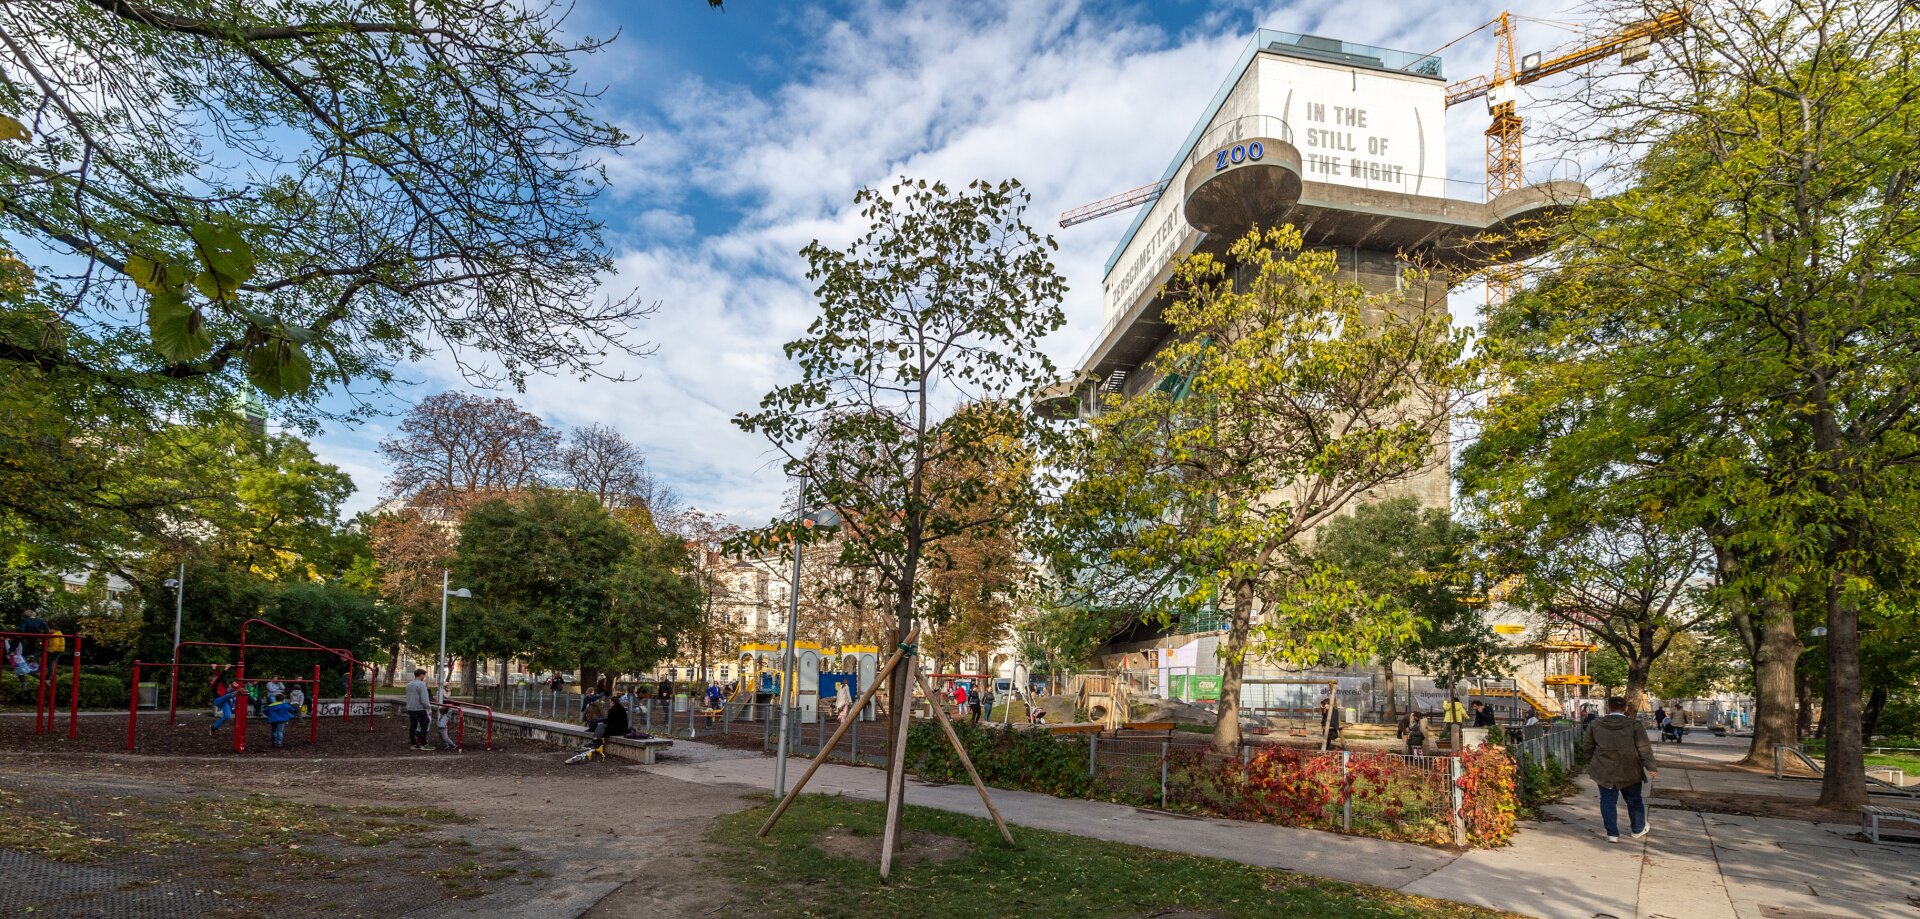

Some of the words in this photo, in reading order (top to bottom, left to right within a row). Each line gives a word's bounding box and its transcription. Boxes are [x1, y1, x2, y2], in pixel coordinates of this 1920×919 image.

[1307, 102, 1325, 122] IN
[1334, 106, 1367, 128] THE
[1216, 141, 1264, 171] ZOO
[1307, 128, 1356, 152] STILL
[1368, 136, 1389, 156] OF
[1308, 153, 1341, 175] THE
[1350, 158, 1403, 183] NIGHT
[1112, 203, 1179, 307] ZERSCHMETTERT
[1320, 688, 1362, 697] alpnverein
